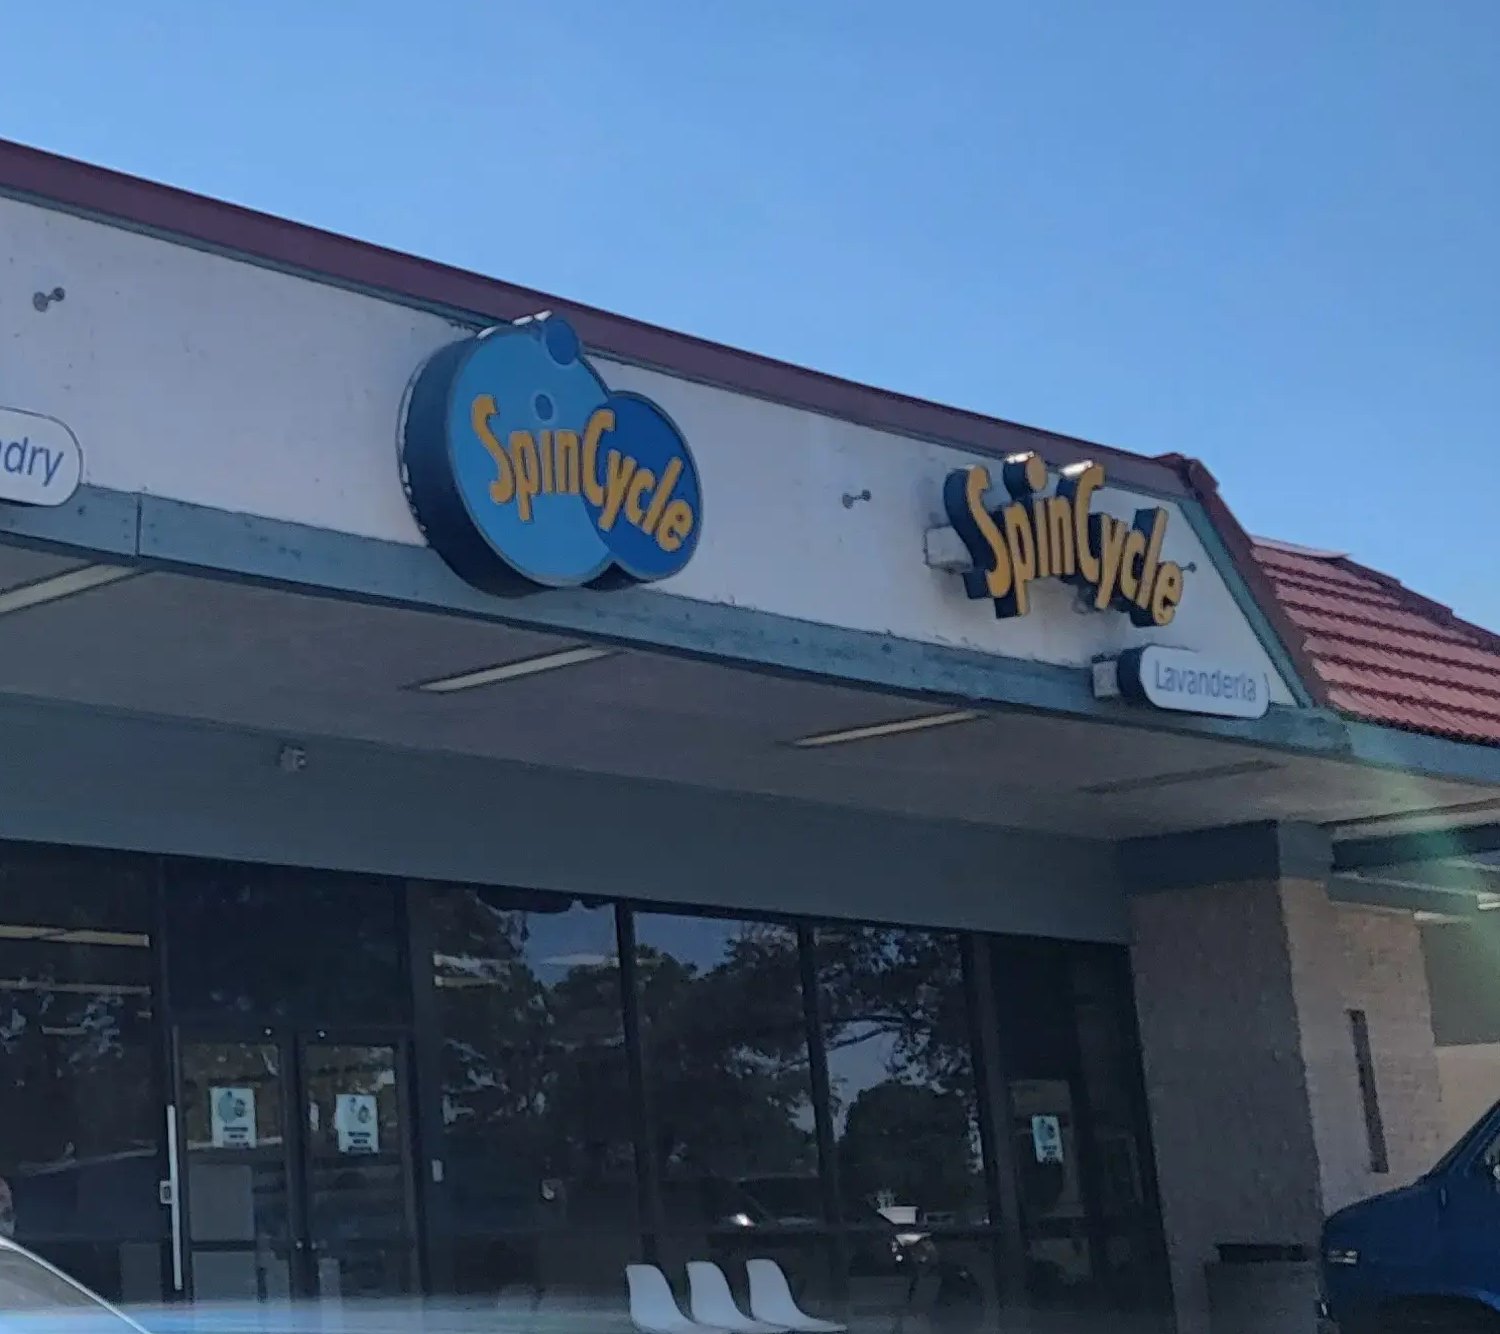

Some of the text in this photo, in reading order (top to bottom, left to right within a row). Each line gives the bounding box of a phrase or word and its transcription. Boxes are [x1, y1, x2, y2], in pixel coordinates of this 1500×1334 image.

[470, 393, 694, 553] SpinCycle
[964, 453, 1184, 627] SpinCycle
[1155, 659, 1257, 703] Lavanderia
